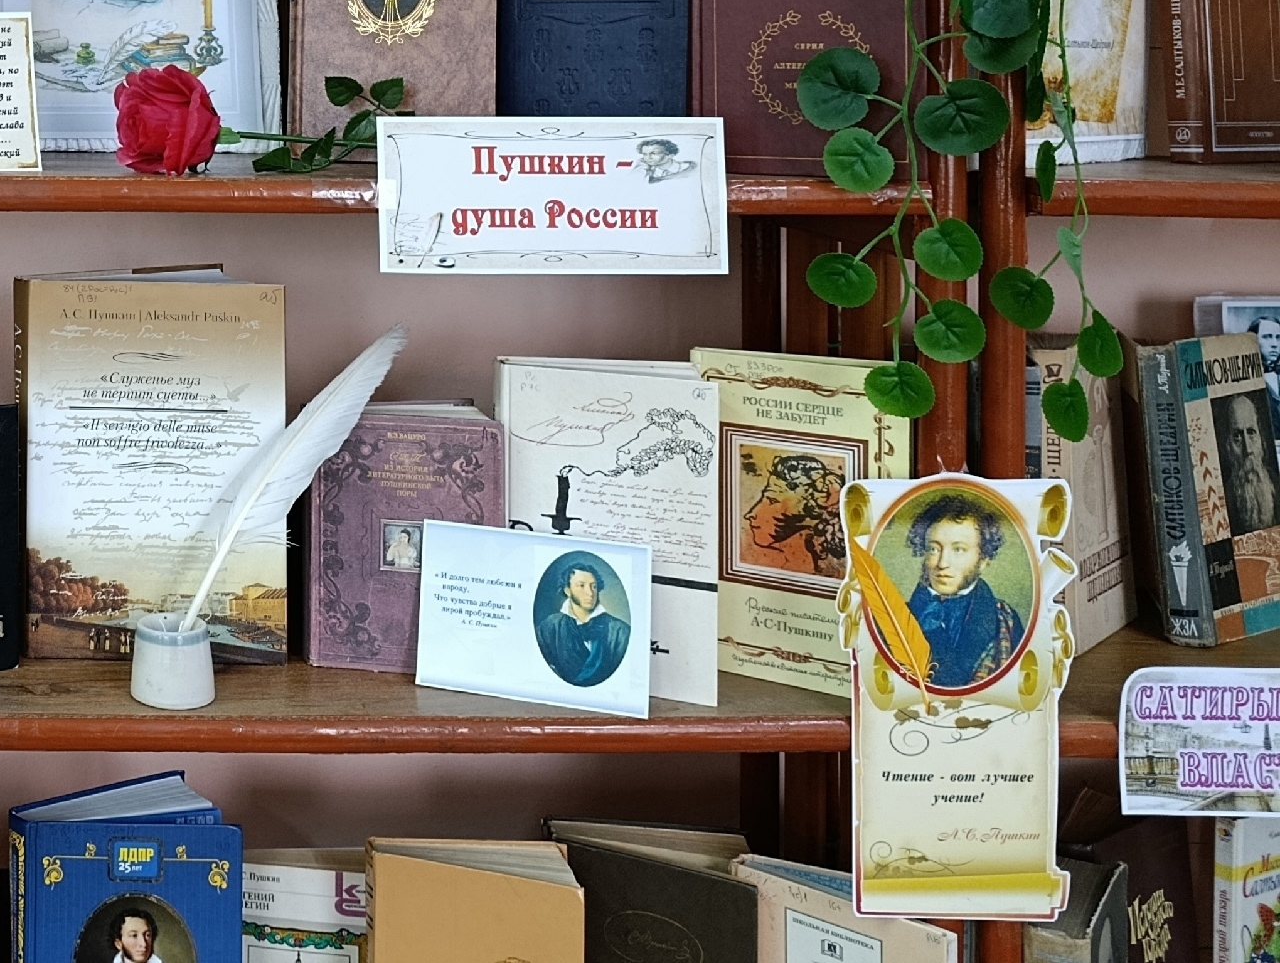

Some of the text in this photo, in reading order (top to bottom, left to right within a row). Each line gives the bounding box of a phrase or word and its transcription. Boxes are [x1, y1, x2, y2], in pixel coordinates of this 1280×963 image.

[0, 26, 12, 34] не
[793, 42, 825, 51] СЕРИЯ
[470, 145, 607, 183] Пушкин
[450, 198, 659, 236] душа России
[145, 309, 201, 323] Aleksandr
[1184, 351, 1263, 390] САЛТЫКОВ-ЩЕДРИН
[100, 371, 202, 388] «Служенье муз
[82, 388, 98, 399] не
[101, 389, 154, 403] терпит
[742, 396, 844, 418] РОССИИ СЕРДЦЕ
[756, 408, 828, 426] НЕ ЗАБУДЕТ
[103, 420, 218, 435] servigio delle muse
[76, 436, 142, 451] non soffre
[367, 471, 424, 480] ЛИТЕРАТУРНОГО
[395, 464, 429, 473] ИСТОРИИ
[1158, 401, 1185, 540] САЛТЫКОВ-ЩЕДРИН
[381, 480, 432, 489] ПУШКИНСКОЙ
[396, 490, 418, 498] ПОРЫ
[448, 574, 470, 584] долго
[471, 577, 485, 585] тем
[450, 596, 478, 607] чувства
[478, 600, 504, 610] добрые
[1170, 616, 1199, 637] ЖЗЛ
[881, 770, 1034, 787] Чтение вот лучшее
[931, 791, 985, 806] учение!
[980, 827, 1041, 845] Пушкин
[118, 847, 155, 864] ЛДПР
[118, 862, 132, 874] 25
